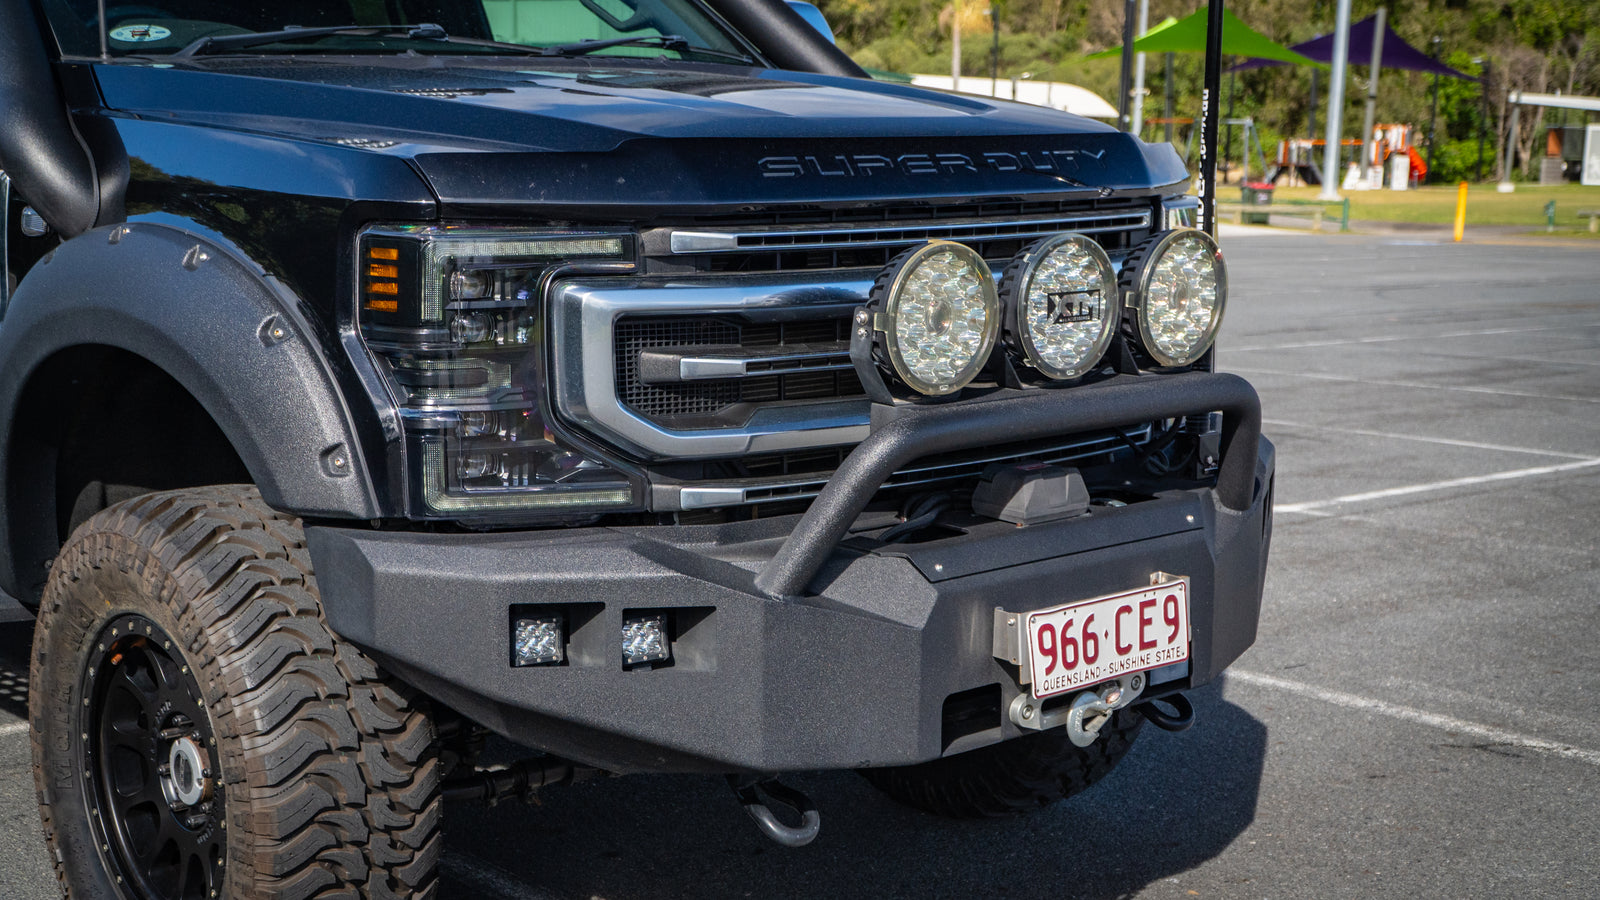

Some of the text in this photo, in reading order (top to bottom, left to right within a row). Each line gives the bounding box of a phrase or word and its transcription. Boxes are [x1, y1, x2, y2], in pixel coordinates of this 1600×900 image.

[757, 149, 1105, 177] SUPER DUTY
[1037, 594, 1180, 676] 966 CE9
[1043, 667, 1100, 692] QUEENSLAND
[1109, 653, 1150, 676] SUNSHINE
[1156, 645, 1181, 663] STATE
